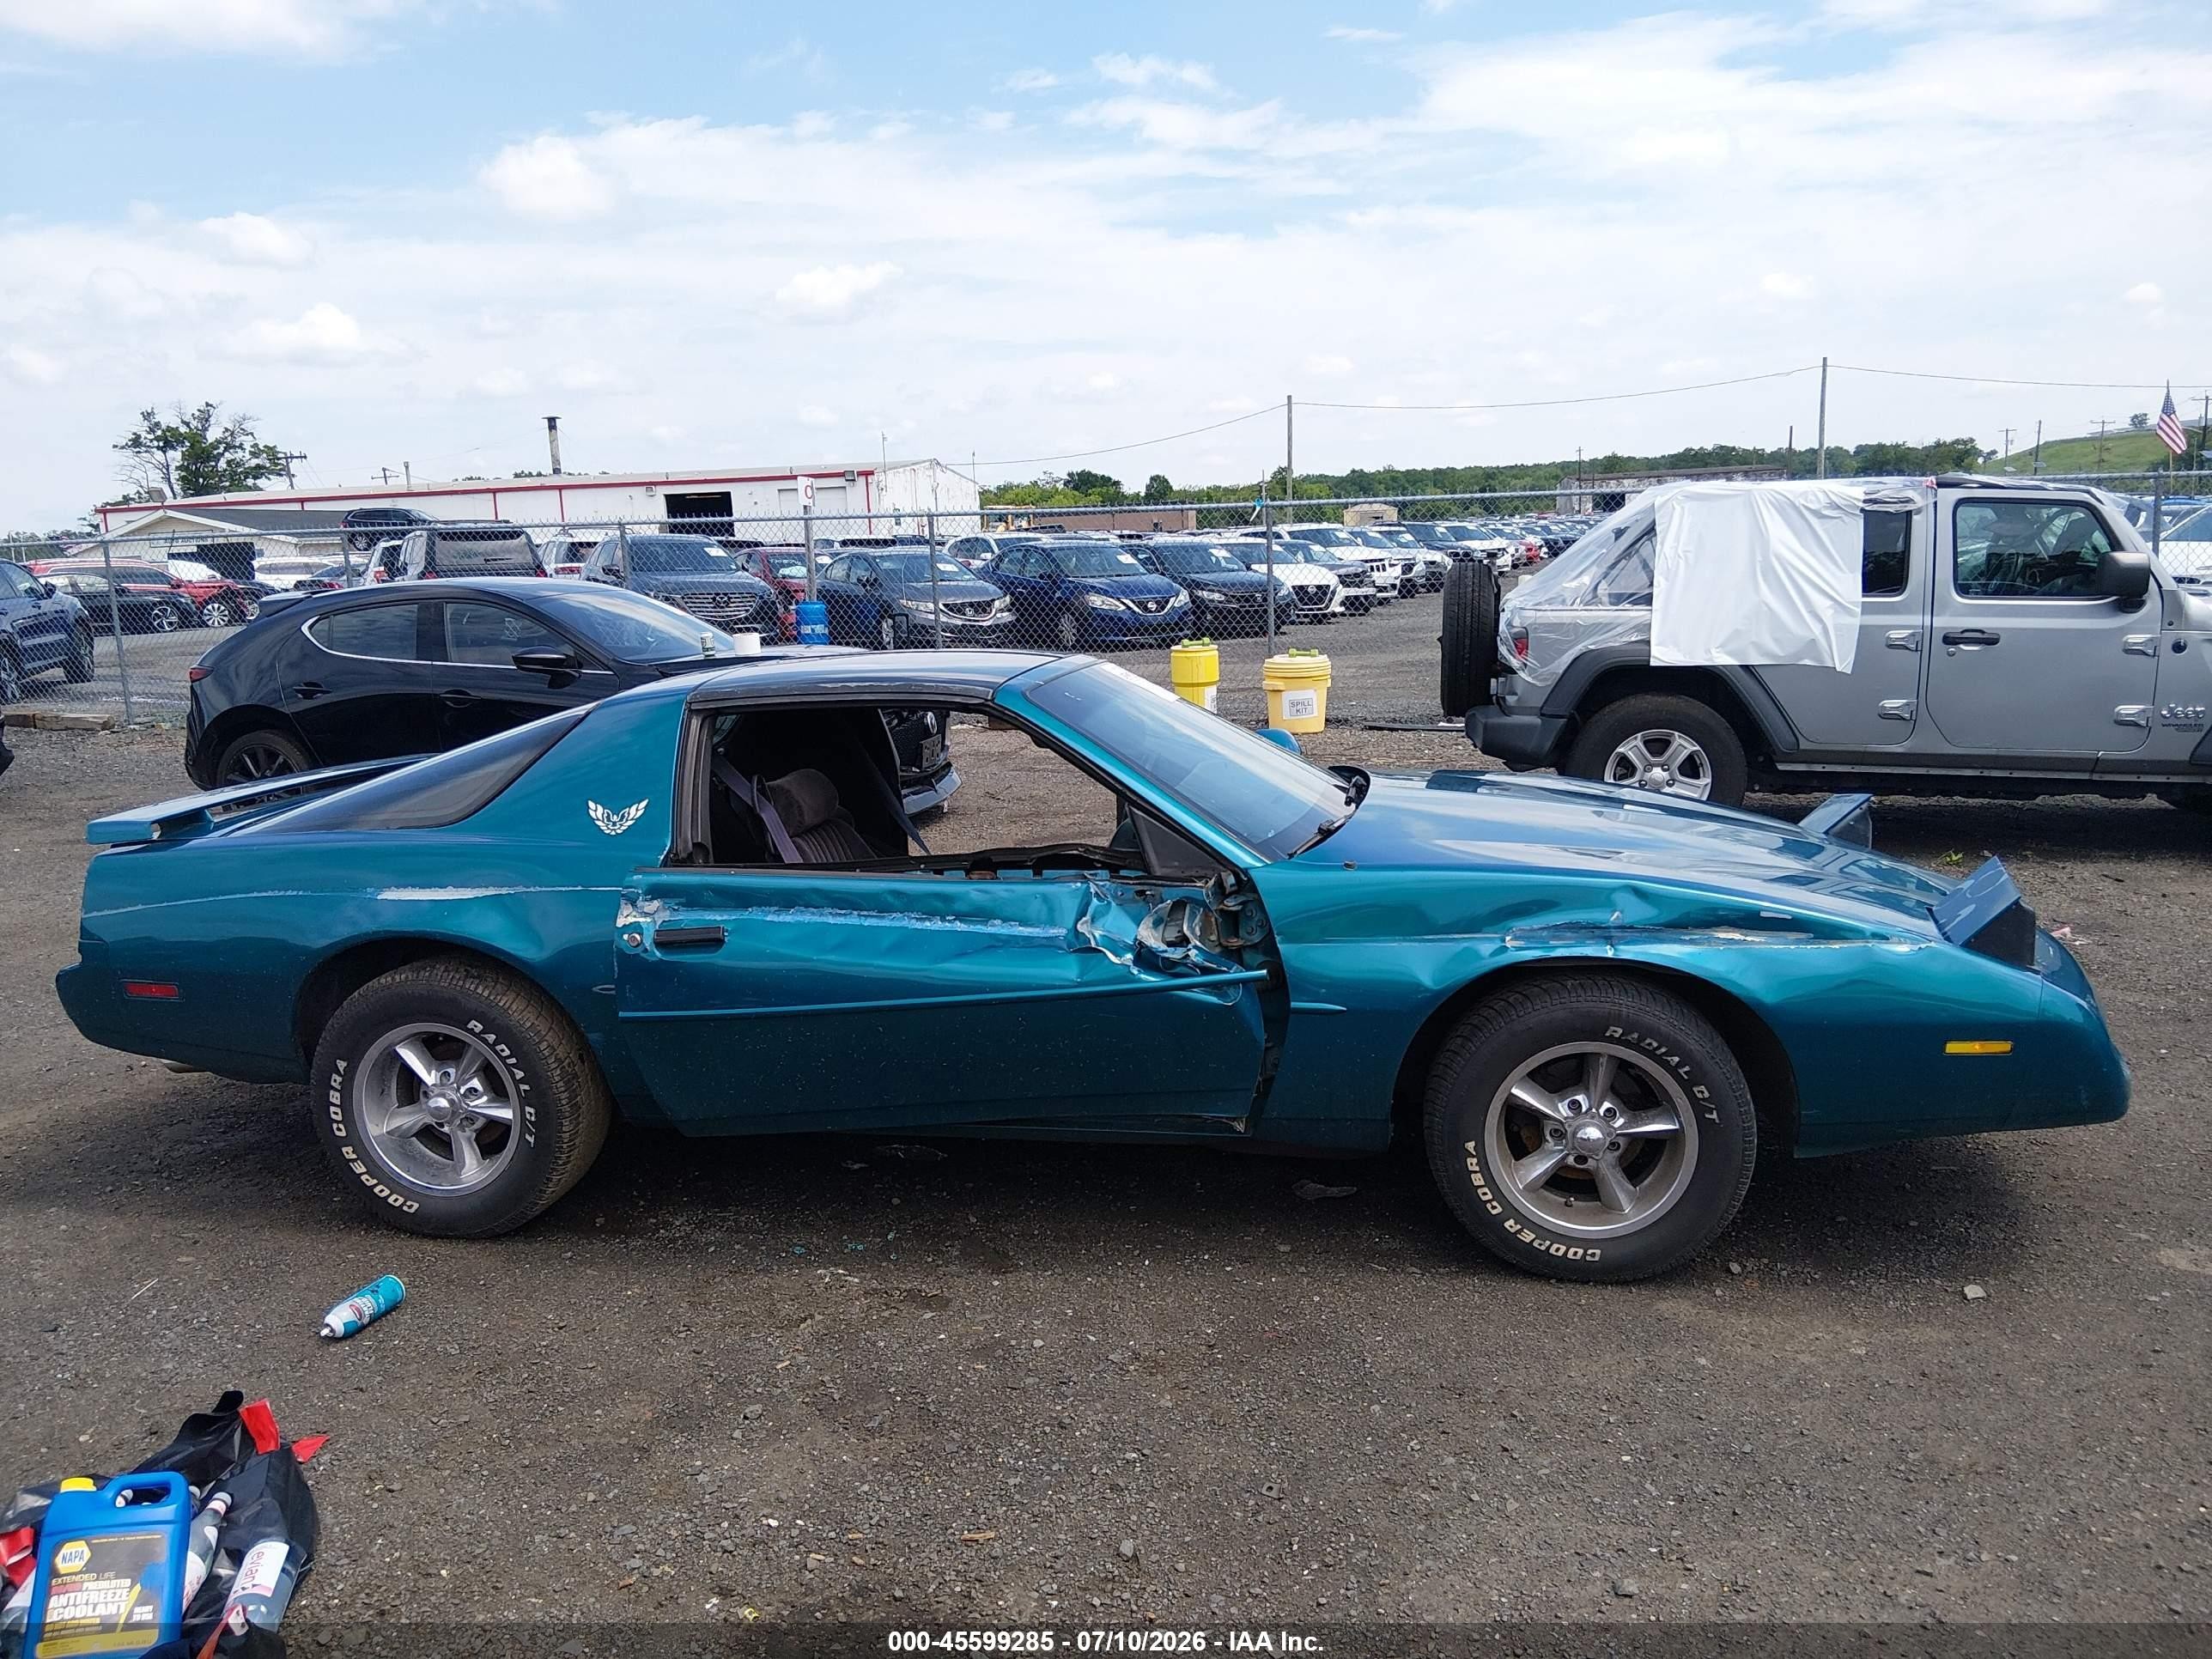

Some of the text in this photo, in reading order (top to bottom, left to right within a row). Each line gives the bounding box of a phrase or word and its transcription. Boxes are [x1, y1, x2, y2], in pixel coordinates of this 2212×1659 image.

[2160, 703, 2206, 719] Jeep
[467, 1019, 537, 1148] RADIAL G/T
[1605, 1026, 1721, 1123] RADIAL G/T
[330, 1059, 420, 1214] COOPER COBRA
[1464, 1139, 1601, 1262] COOPER COBRA
[61, 1549, 85, 1565] NAPA
[241, 1551, 264, 1587] evian
[52, 1571, 116, 1585] EXTENDED LIFE
[48, 1588, 131, 1609] ANTIFREEZE
[53, 1601, 129, 1621] COOLANT
